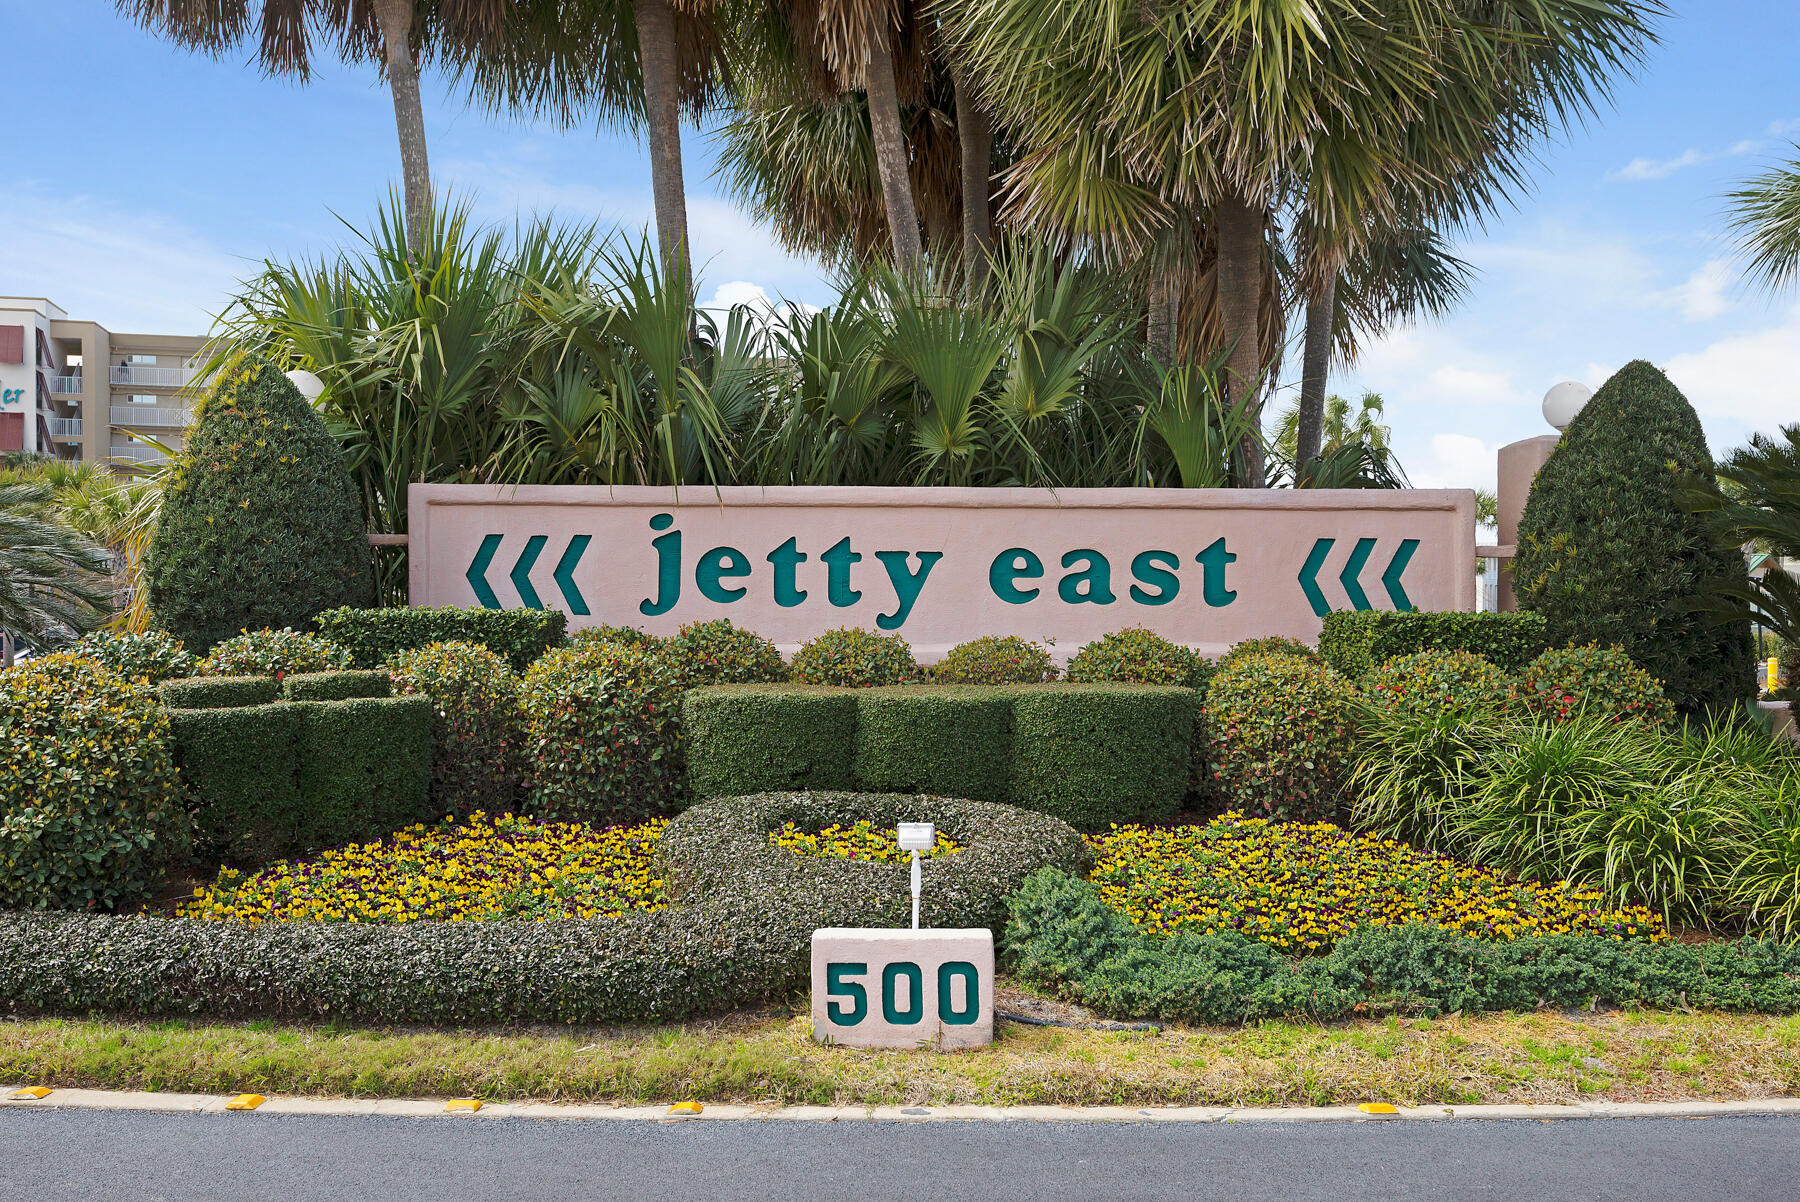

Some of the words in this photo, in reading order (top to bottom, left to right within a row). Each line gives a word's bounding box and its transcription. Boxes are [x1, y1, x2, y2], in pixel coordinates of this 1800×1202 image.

[640, 514, 943, 631] jetty
[989, 537, 1237, 608] east
[827, 961, 980, 1027] 500
